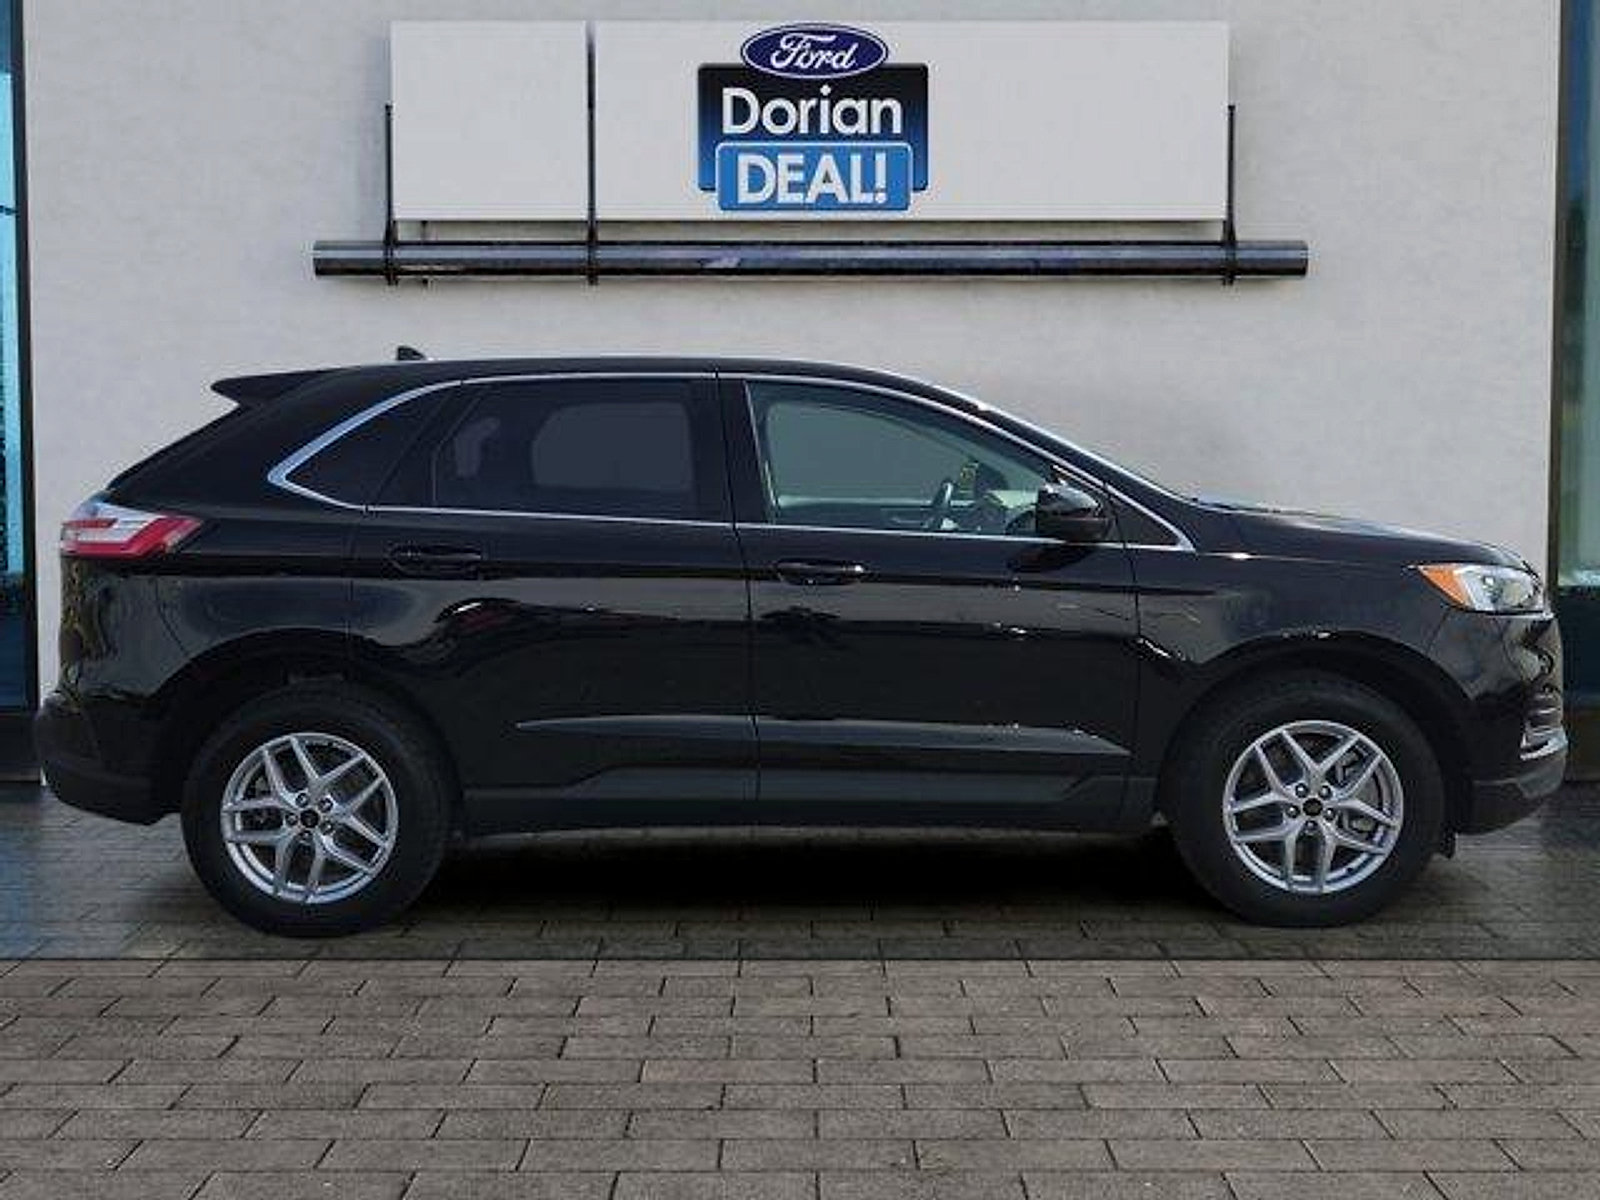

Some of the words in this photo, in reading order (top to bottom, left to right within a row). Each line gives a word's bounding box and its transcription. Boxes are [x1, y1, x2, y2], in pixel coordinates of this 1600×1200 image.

[770, 32, 858, 69] Ford
[722, 85, 902, 134] Dorian
[737, 153, 886, 203] DEAL!
